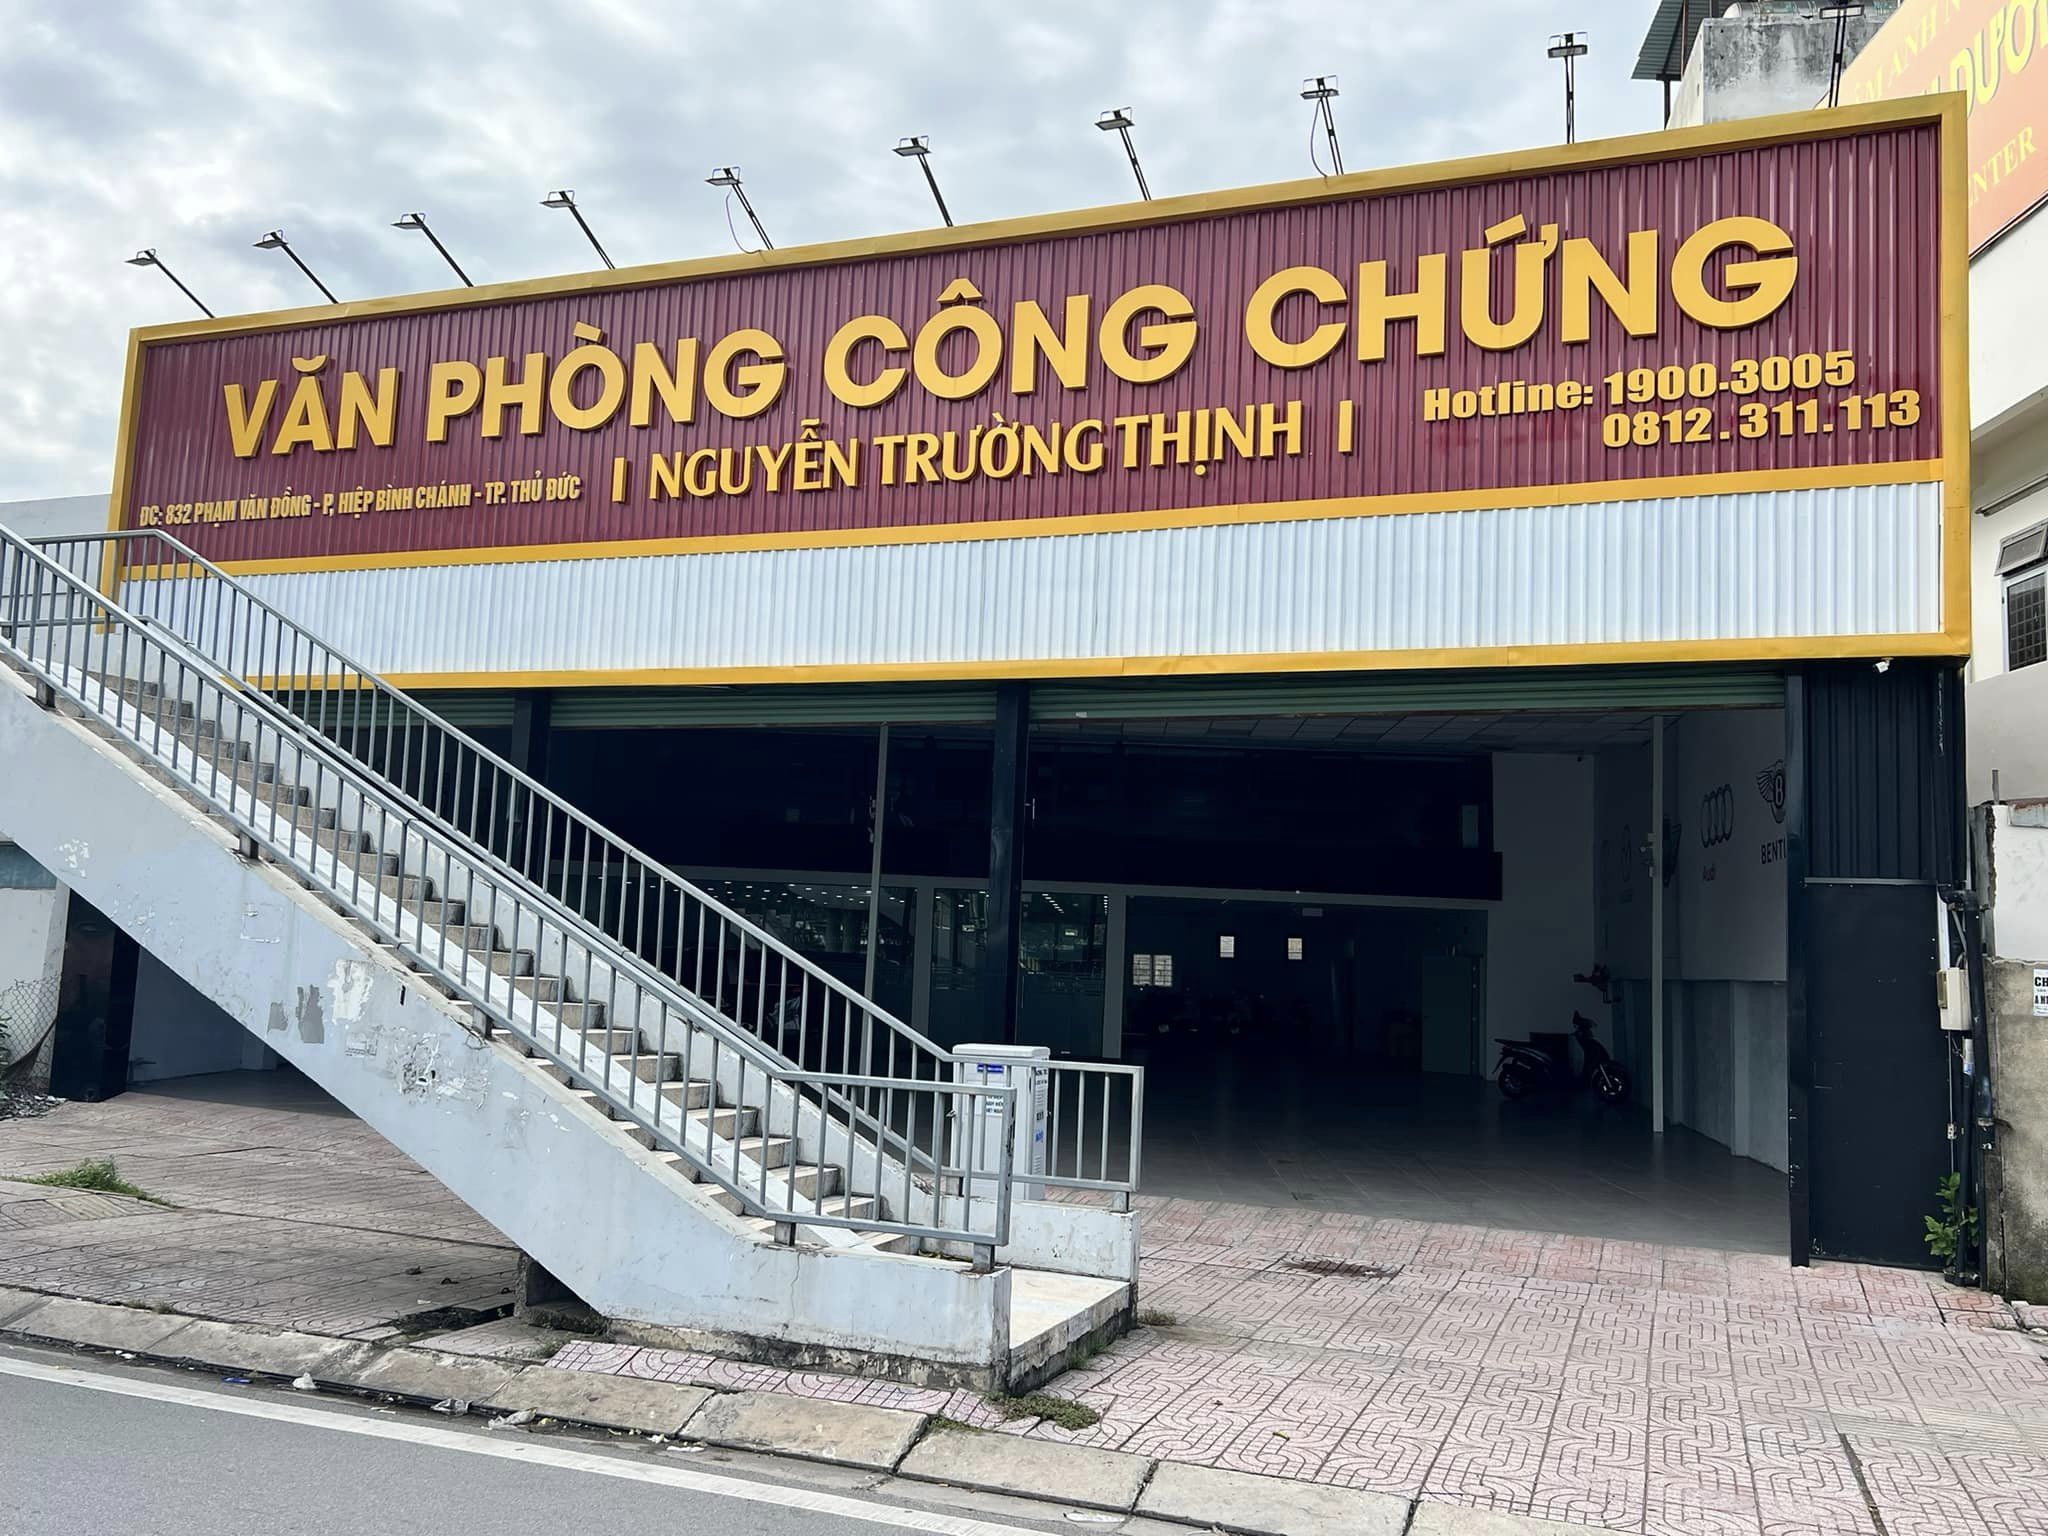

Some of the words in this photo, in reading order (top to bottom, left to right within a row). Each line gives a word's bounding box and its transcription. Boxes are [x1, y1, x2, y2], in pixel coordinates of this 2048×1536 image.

[224, 354, 398, 457] VĂN
[426, 321, 787, 444] PHÒNG
[824, 277, 1197, 406] CÔNG
[1244, 213, 1799, 369] CHỨNG
[1424, 380, 1593, 421] Hotline:
[649, 418, 857, 499] NGUYỄN
[873, 410, 1103, 484] TRƯỜNG
[1114, 400, 1301, 475] THỊNH
[165, 502, 193, 526] 832
[193, 499, 237, 528] PHẠM
[239, 493, 268, 521] VĂN
[270, 485, 312, 519] ĐỒNG
[337, 485, 375, 519] HIỆP
[375, 484, 413, 512] BÌNH
[415, 480, 471, 509] CHÁNH
[485, 481, 507, 505] TP.
[511, 470, 543, 504] THỦ
[545, 471, 582, 501] ĐỨC
